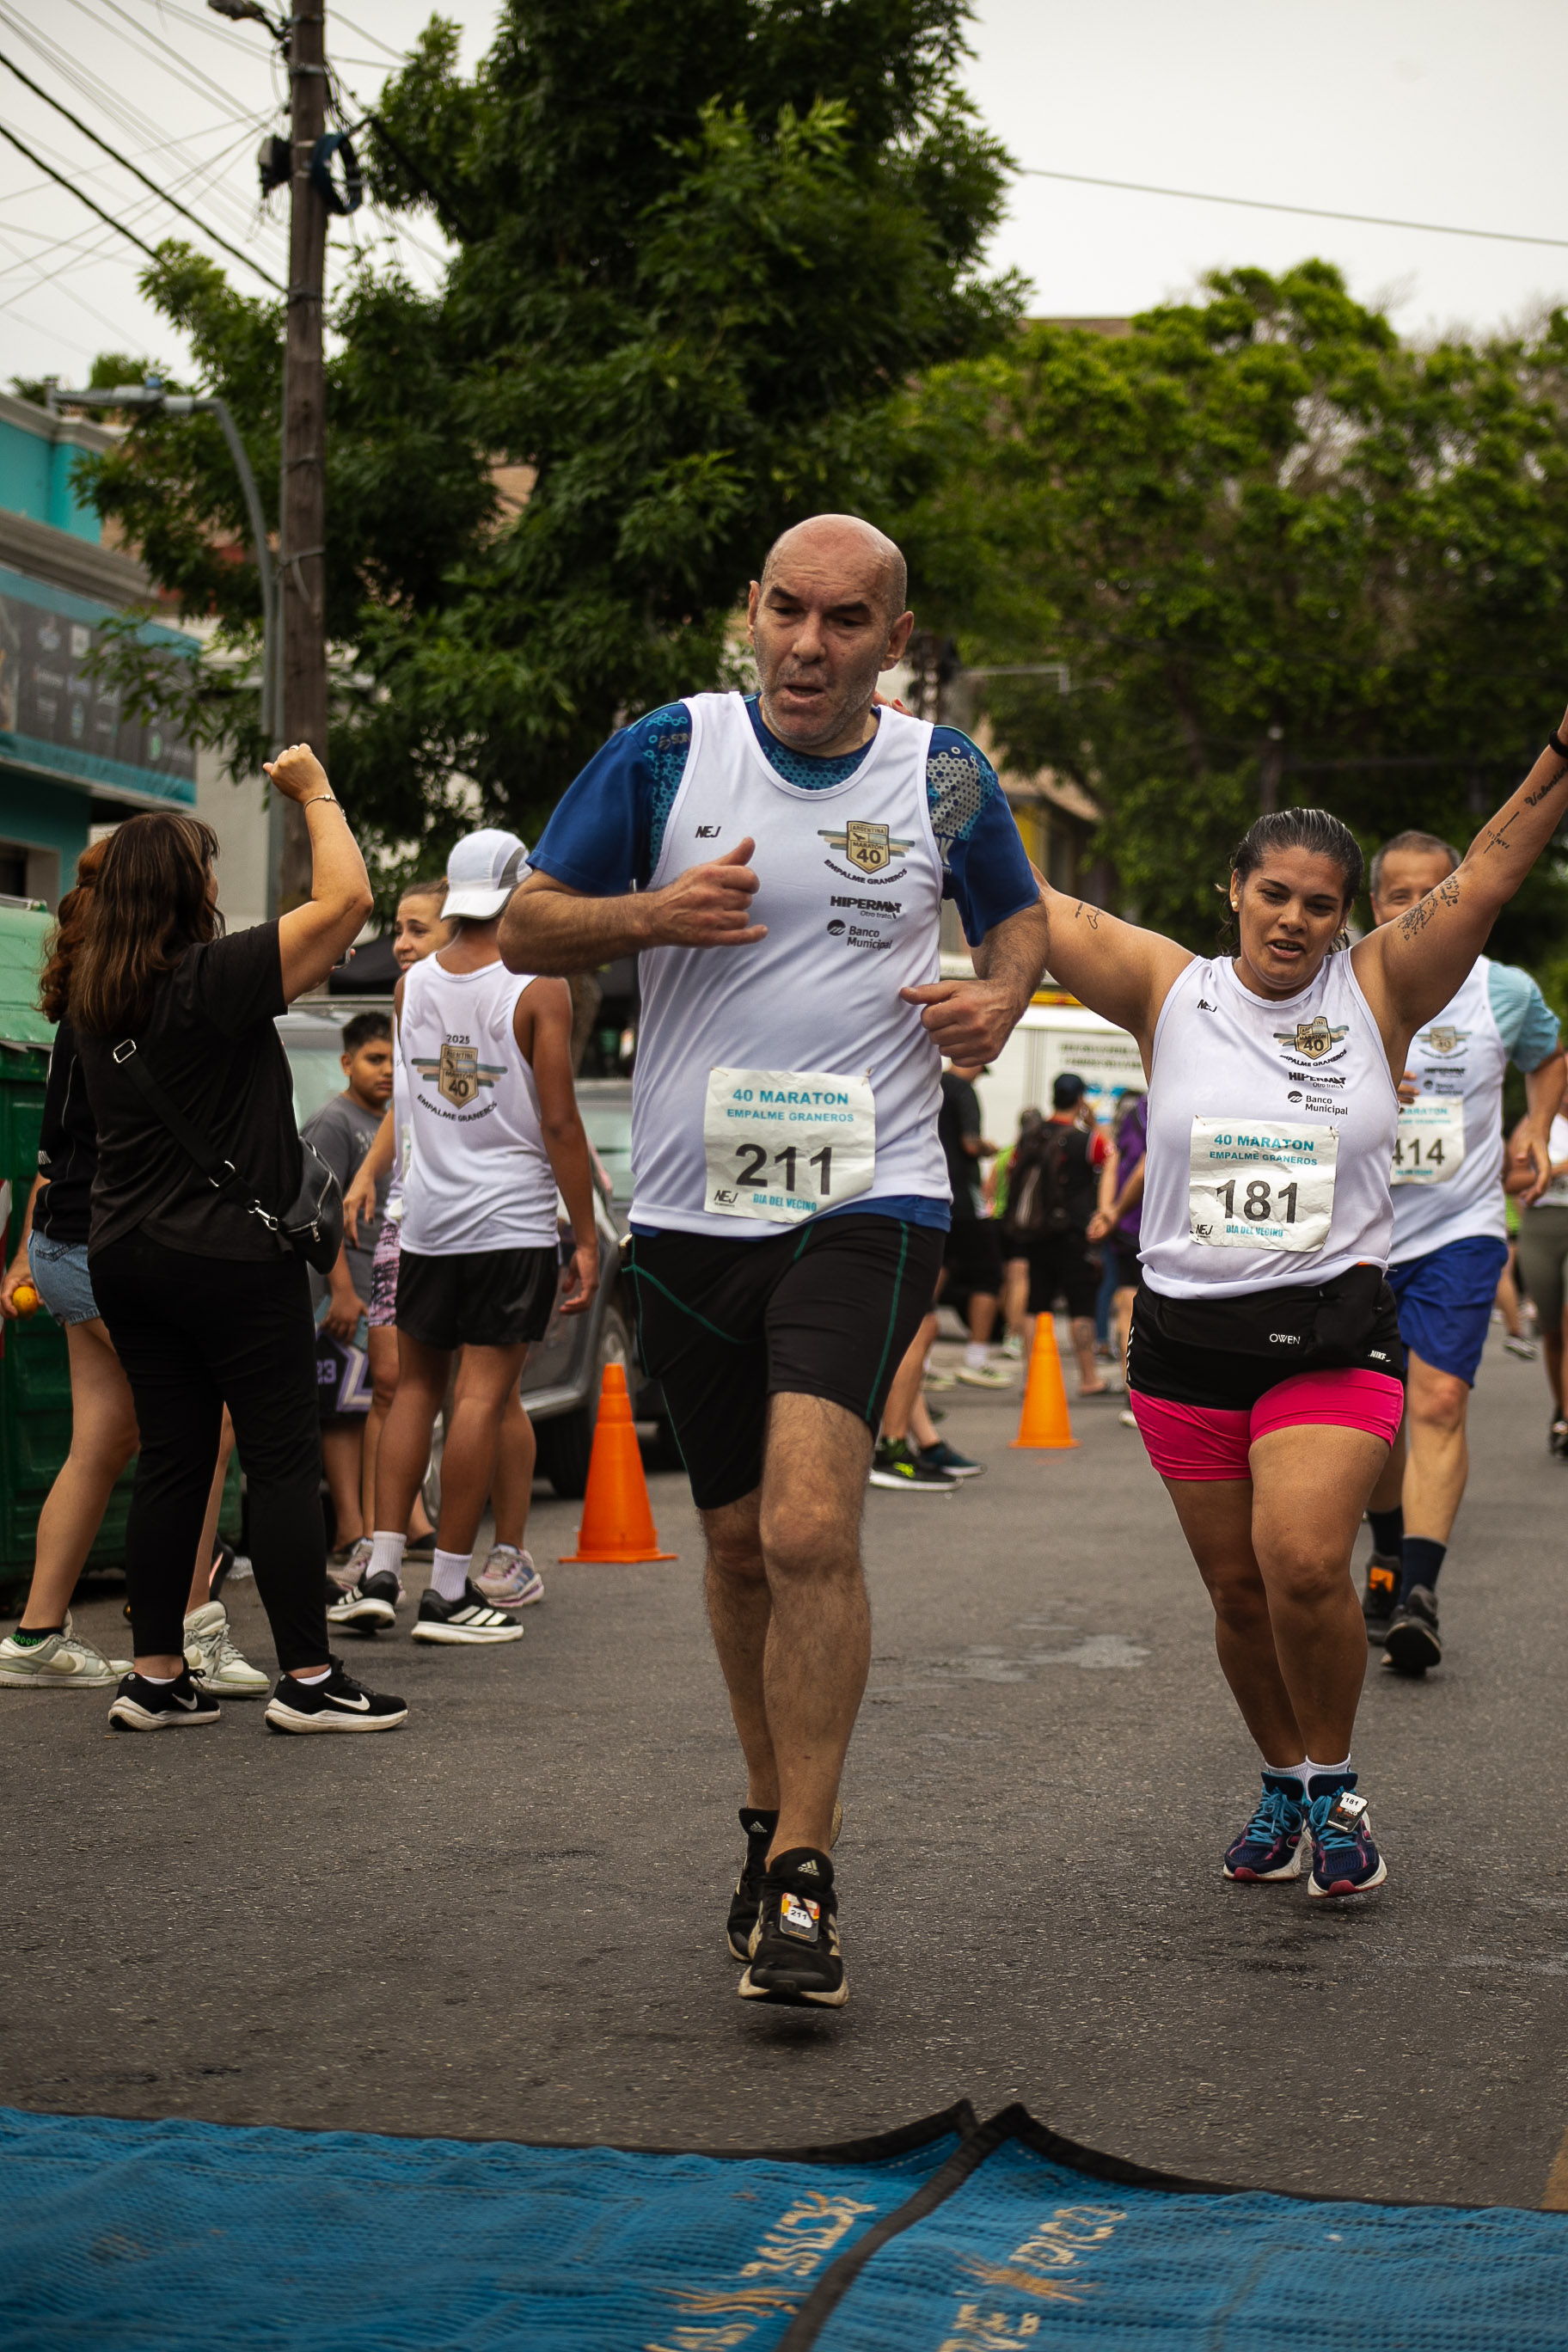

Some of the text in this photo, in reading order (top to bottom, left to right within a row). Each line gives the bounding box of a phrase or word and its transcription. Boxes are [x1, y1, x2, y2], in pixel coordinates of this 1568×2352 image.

[695, 825, 720, 839] NEJ
[852, 825, 885, 834] ARGENTINA
[856, 848, 881, 865] 40
[824, 859, 908, 885] EMPALME GRANEROS
[860, 910, 875, 918] Otro
[848, 926, 880, 939] Banco
[847, 937, 892, 950] Municipal
[446, 1034, 470, 1044] 2025
[1303, 1039, 1324, 1051] 40
[1313, 1049, 1348, 1066] GRANEROS
[449, 1080, 469, 1097] 40
[732, 1088, 849, 1106] 40 MARATON
[1306, 1095, 1332, 1104] Banco
[417, 1093, 497, 1123] EMPALME GRANEROS
[1305, 1104, 1348, 1116] Municipal
[727, 1109, 854, 1123] EMPALME GRANEROS
[1214, 1135, 1315, 1152] 40 MARATON
[1209, 1151, 1318, 1166] EMPALME GRANEROS
[1393, 1138, 1446, 1166] 414
[736, 1143, 832, 1196] 211
[714, 1190, 739, 1204] NEJ
[753, 1193, 817, 1212] DIA DEL VECINO
[1216, 1179, 1298, 1224] 181
[1196, 1224, 1214, 1234] NEJ
[1226, 1224, 1239, 1233] DIA
[1240, 1226, 1253, 1234] DEL
[1269, 1332, 1302, 1344] OWEN
[1345, 1797, 1359, 1805] 181
[791, 1910, 808, 1920] 211
